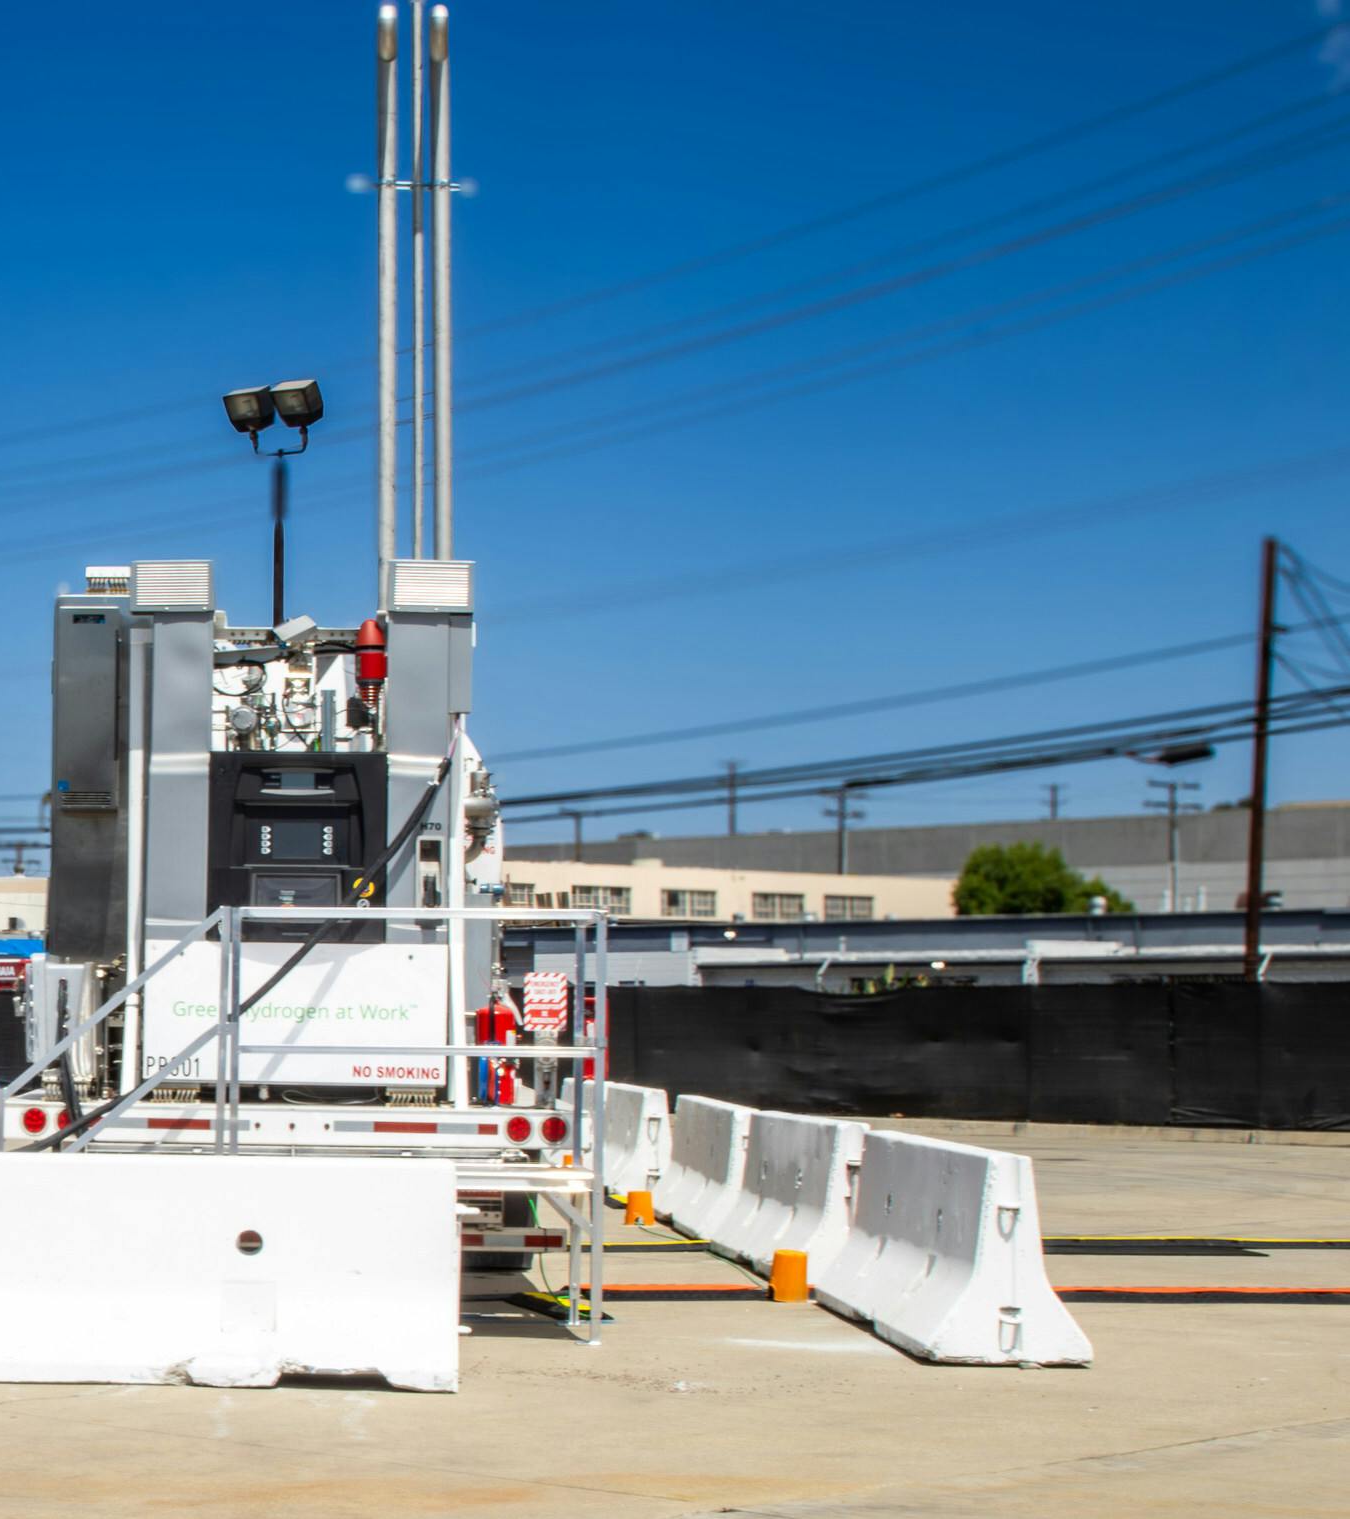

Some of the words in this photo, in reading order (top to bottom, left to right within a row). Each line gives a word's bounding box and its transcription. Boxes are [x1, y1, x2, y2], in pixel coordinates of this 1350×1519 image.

[420, 822, 442, 831] H70
[172, 1001, 219, 1018] Gree
[335, 1005, 354, 1020] at
[352, 1065, 372, 1078] NO
[377, 1066, 440, 1080] SMOKING
